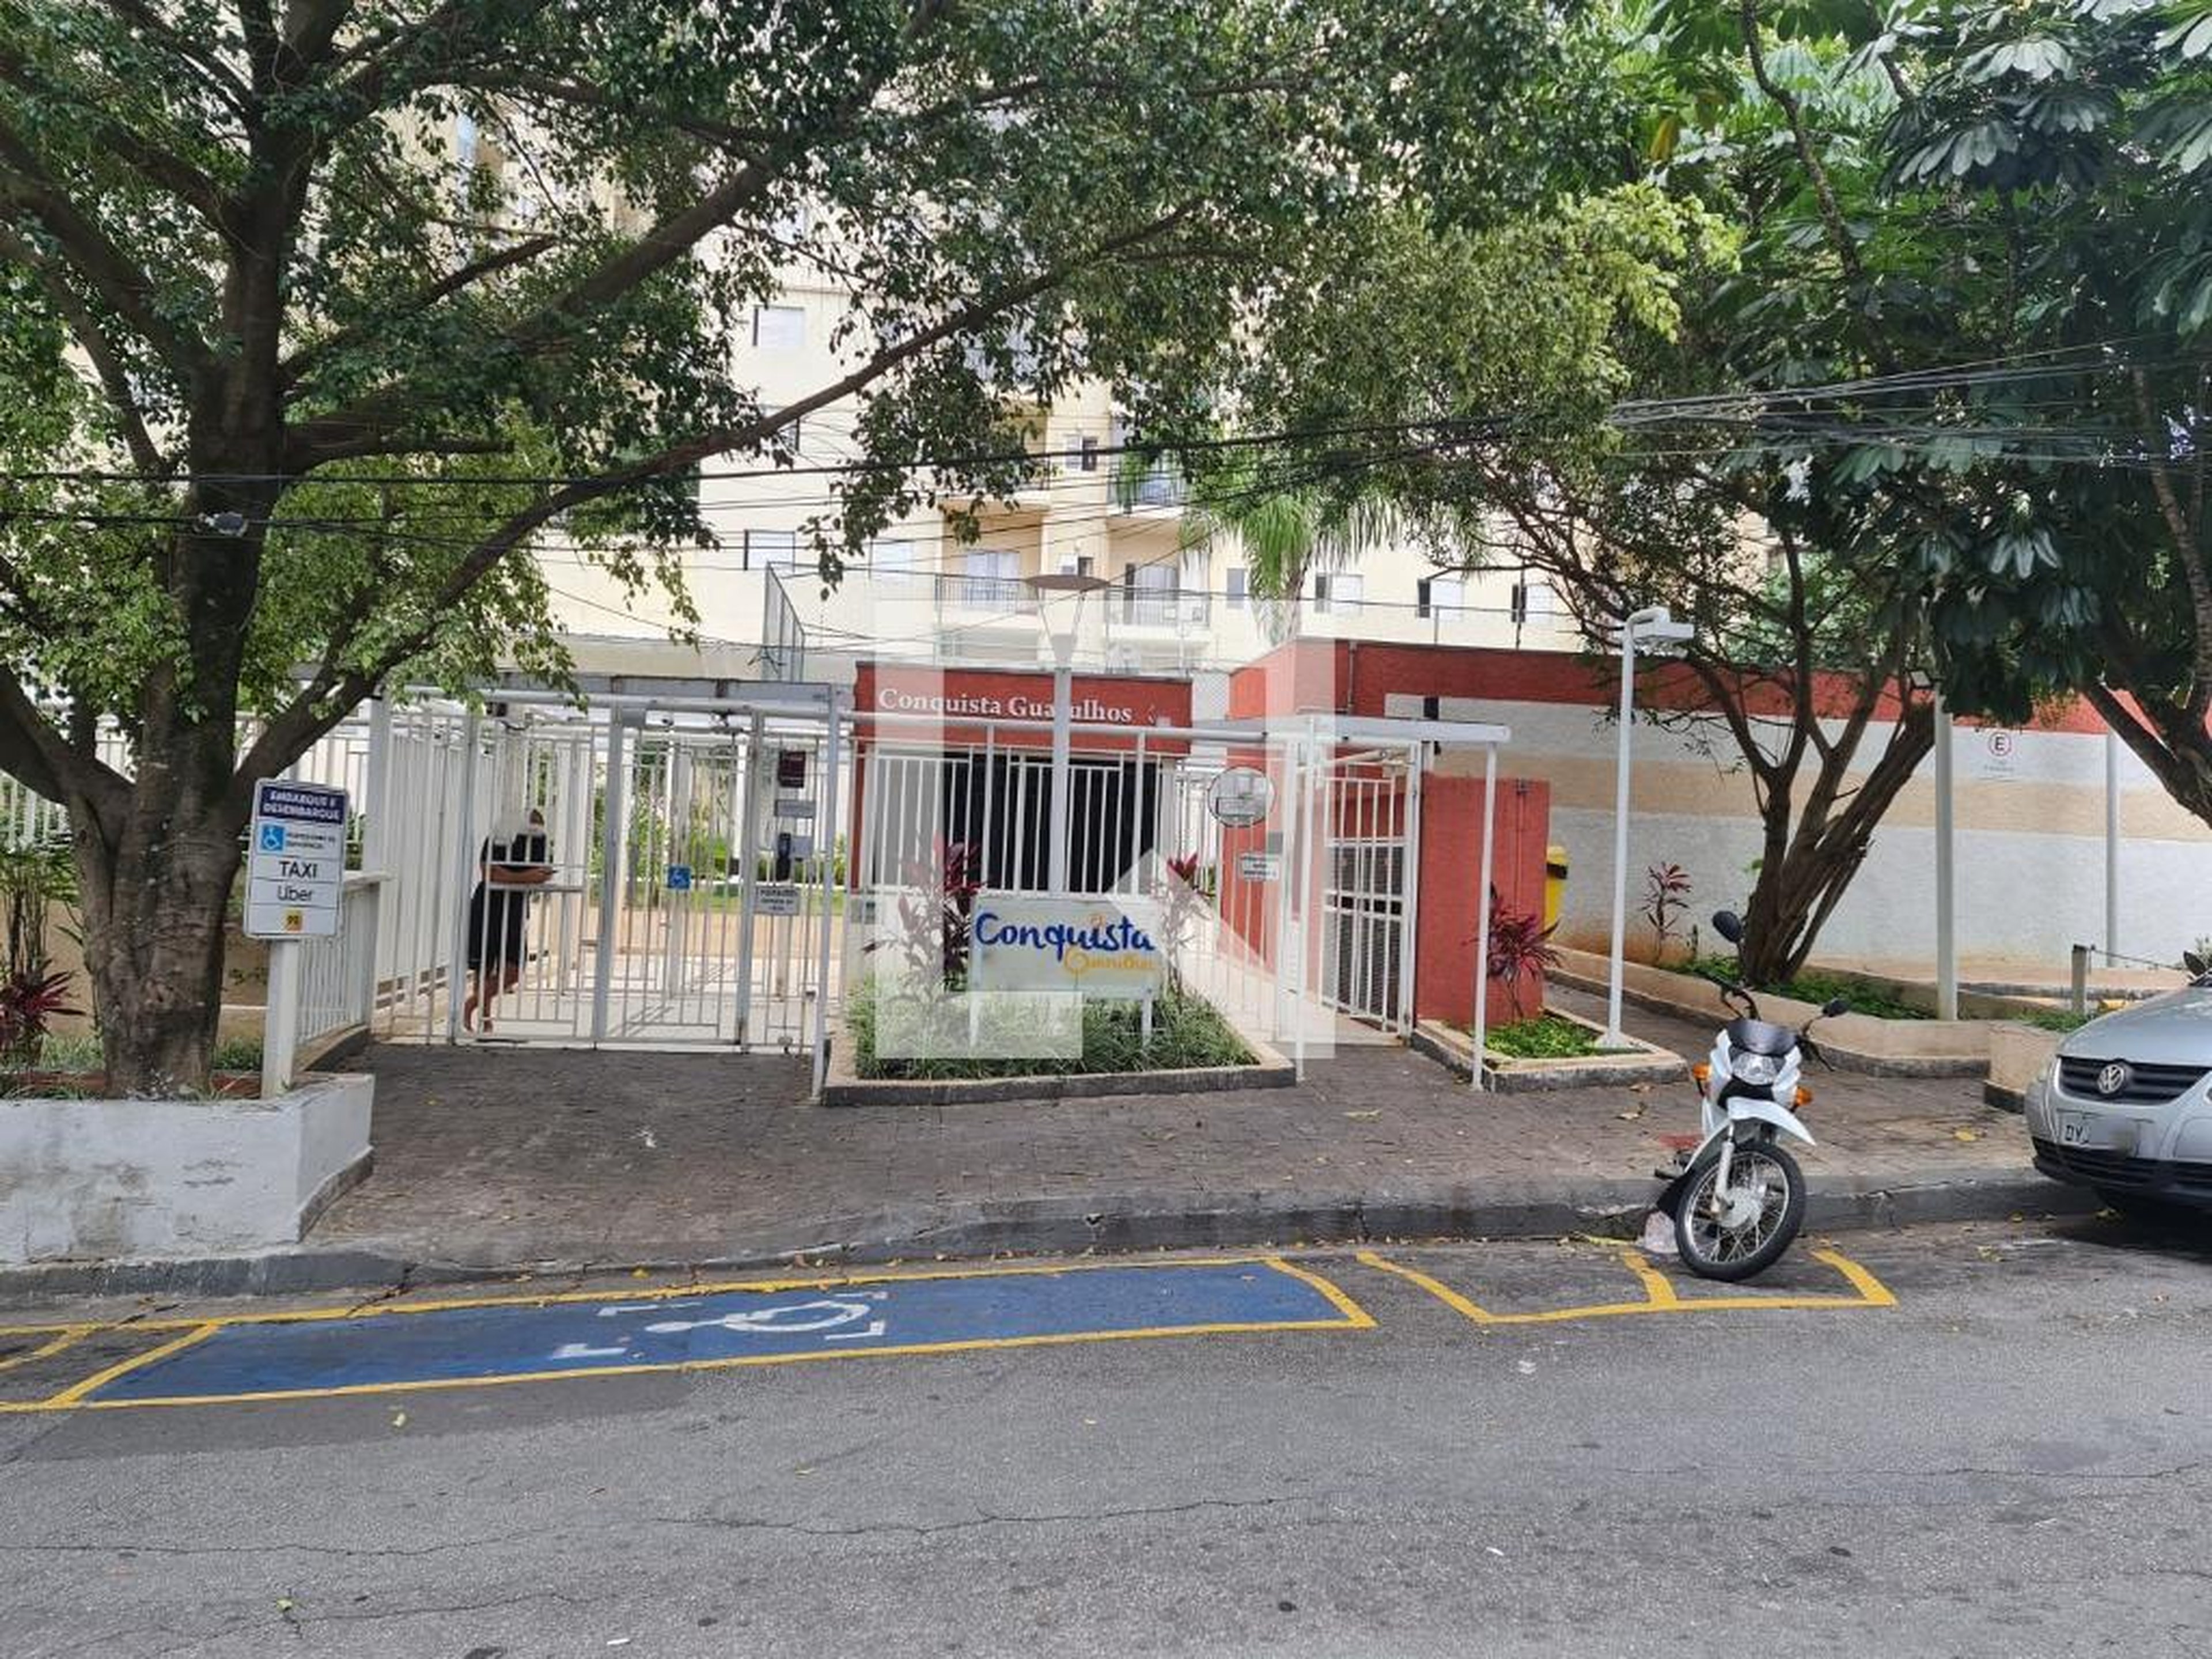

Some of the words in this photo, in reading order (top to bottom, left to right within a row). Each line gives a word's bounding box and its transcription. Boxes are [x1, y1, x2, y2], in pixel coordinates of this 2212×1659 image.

[879, 688, 1002, 716] Conquista
[1009, 696, 1132, 722] Guaulhos
[1995, 737, 2005, 751] E
[279, 861, 317, 878] TAXI
[278, 885, 312, 901] Uber
[976, 913, 1154, 962] Conquista
